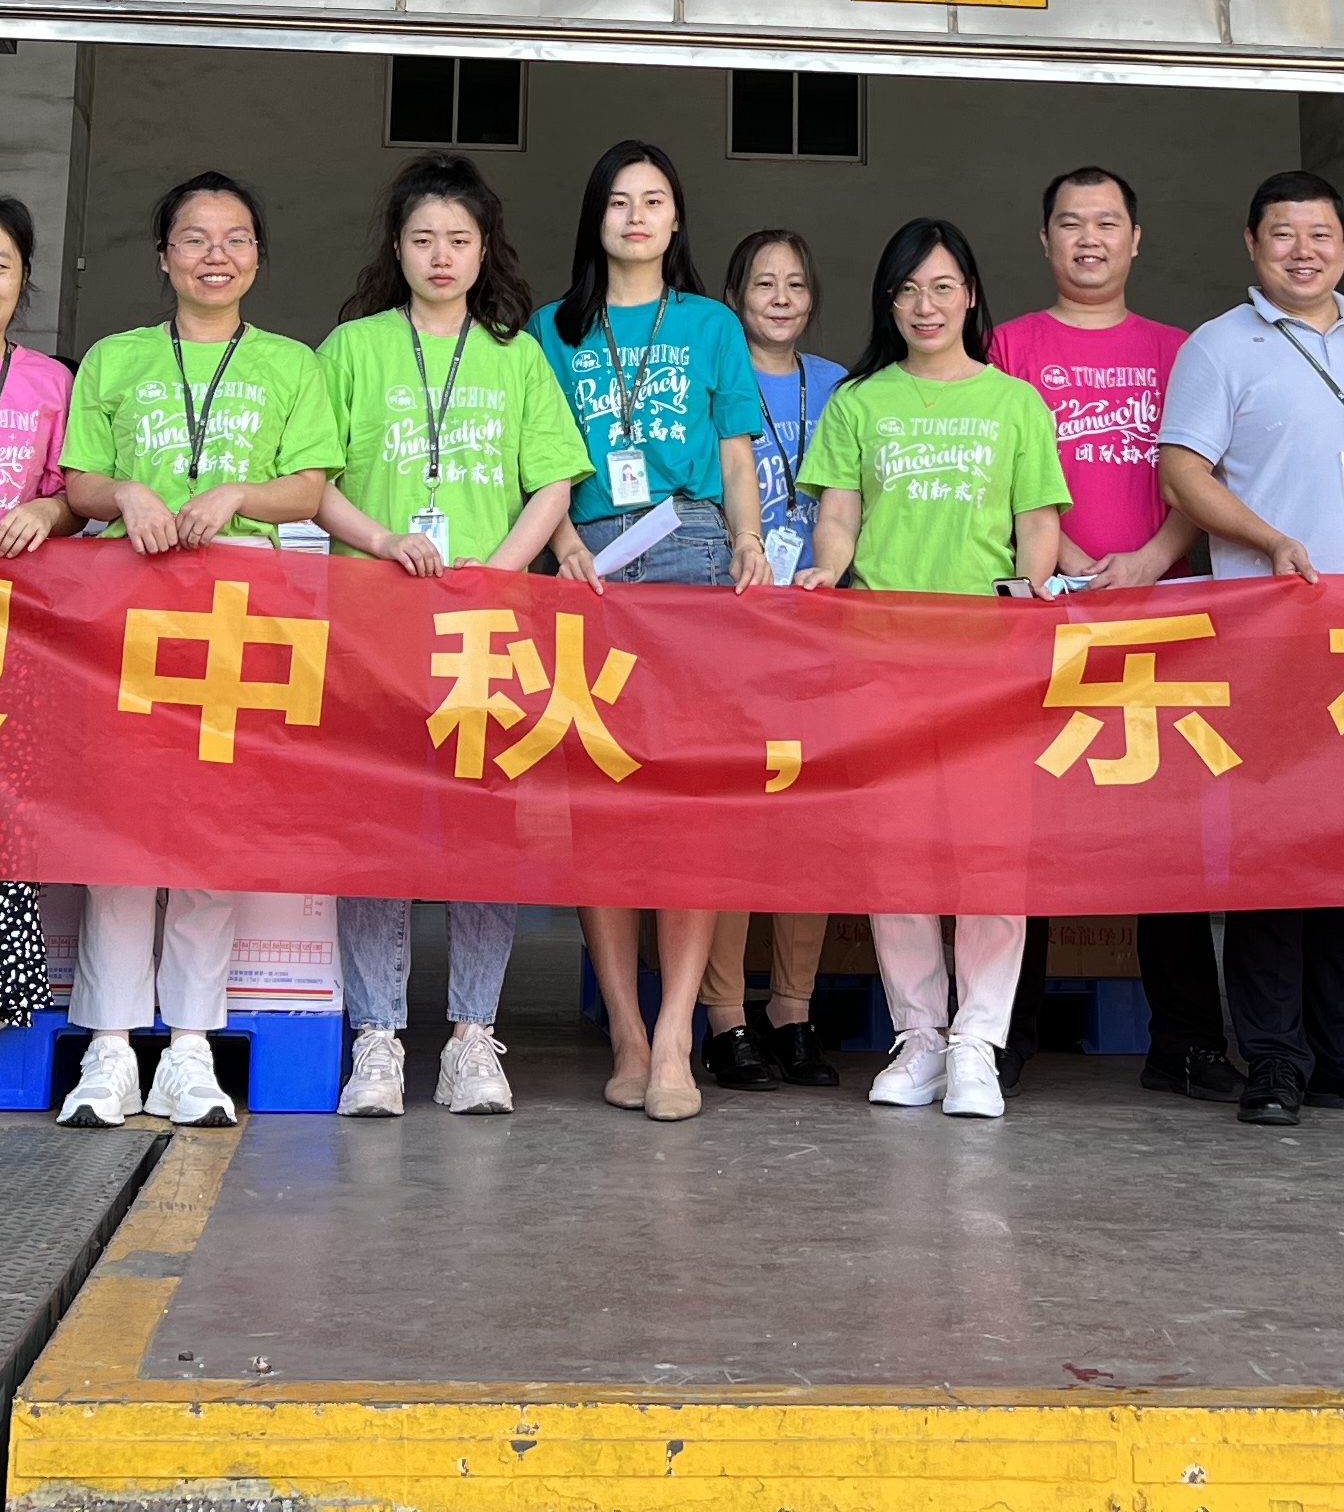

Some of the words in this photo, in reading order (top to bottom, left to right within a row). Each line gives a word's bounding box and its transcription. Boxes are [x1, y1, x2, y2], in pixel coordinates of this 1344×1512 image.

[575, 367, 691, 418] Profiency
[1071, 365, 1157, 388] TUNGHING
[135, 408, 263, 457] Innoation
[382, 418, 504, 462] Innvation
[910, 417, 999, 441] TUNGHING
[874, 442, 995, 483] Innovation
